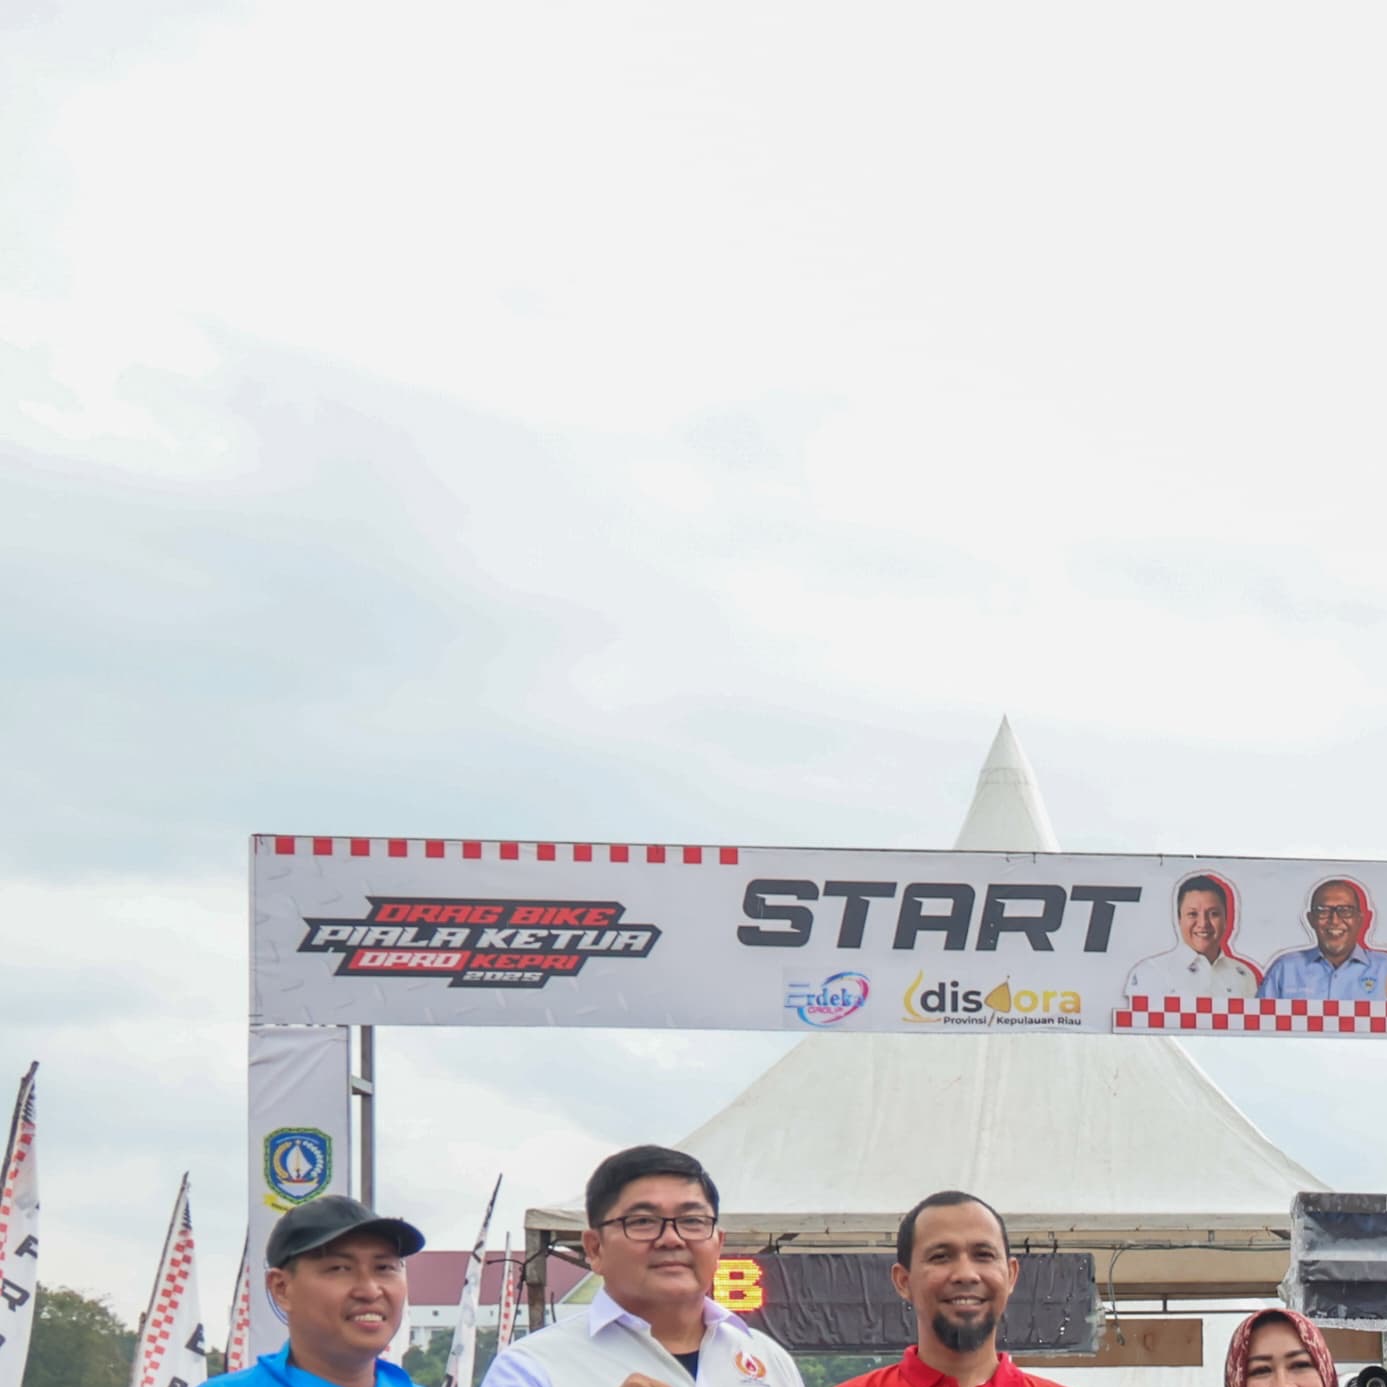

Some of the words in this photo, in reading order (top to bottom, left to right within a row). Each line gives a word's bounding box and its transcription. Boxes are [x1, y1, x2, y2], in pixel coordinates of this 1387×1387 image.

[374, 903, 504, 925] DRAG
[508, 905, 617, 926] BIKE
[737, 879, 1143, 953] START
[311, 925, 465, 948] PIALA
[475, 928, 653, 951] KETUA
[358, 952, 463, 969] DPRD
[470, 954, 581, 970] KEPRI
[462, 971, 544, 982] 2025
[943, 1016, 987, 1026] Provinsi
[996, 1016, 1054, 1026] Kepulauan
[1057, 1016, 1082, 1026] Riau
[713, 1259, 763, 1312] B
